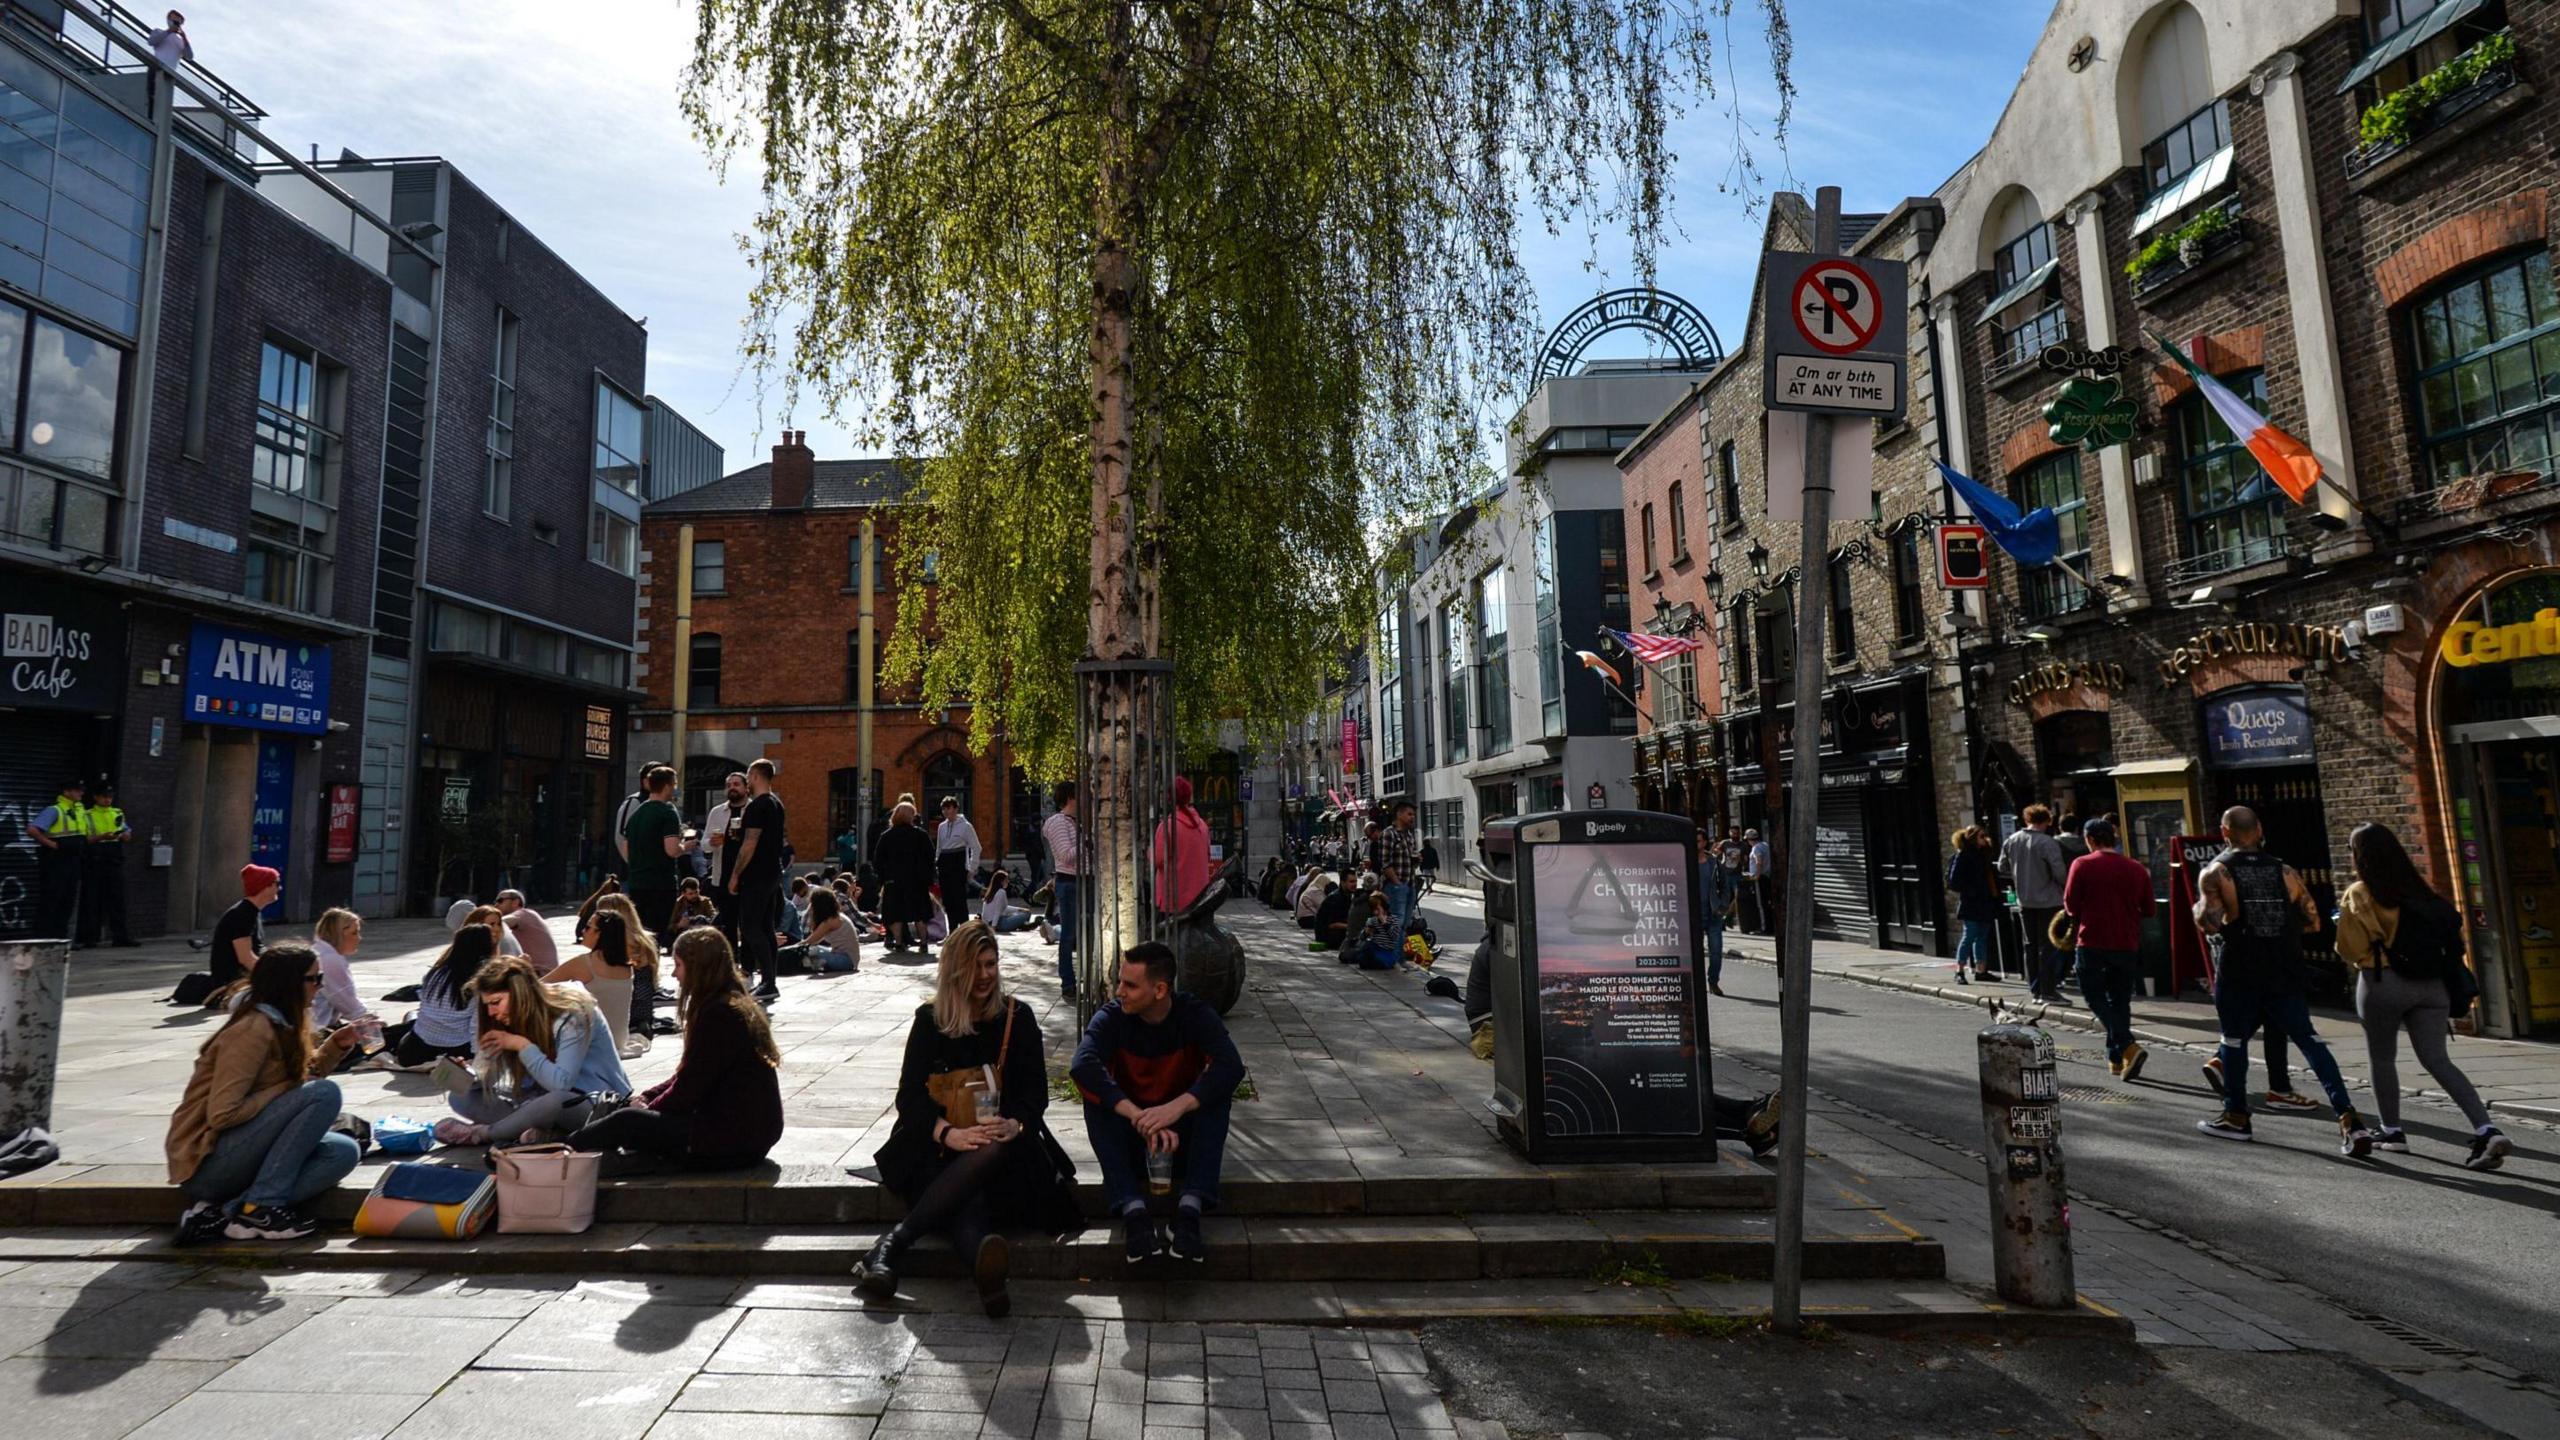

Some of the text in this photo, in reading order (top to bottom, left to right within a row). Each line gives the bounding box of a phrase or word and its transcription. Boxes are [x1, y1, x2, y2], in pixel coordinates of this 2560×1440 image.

[1556, 309, 1603, 355] UNION
[1605, 299, 1649, 320] ONLY
[1671, 311, 1712, 360] TRUTH
[2044, 345, 2132, 372] Quays
[1826, 369, 1841, 381] ar
[1788, 382, 1882, 400] AT ANY TIME
[213, 638, 287, 688] ATM
[290, 678, 314, 692] CASH
[2226, 701, 2286, 734] Quays
[255, 809, 284, 824] ATM
[2184, 844, 2229, 862] QUAY
[1619, 867, 1677, 877] FORBARTHA
[1622, 933, 1680, 947] CLIATH
[1589, 977, 1616, 985] NOCHT
[1580, 986, 1607, 994] MAIDIR
[1618, 985, 1656, 993] FORBAIRT
[1657, 985, 1668, 993] AR
[1669, 985, 1682, 993] DO
[2012, 1107, 2049, 1121] OPTIMIST
